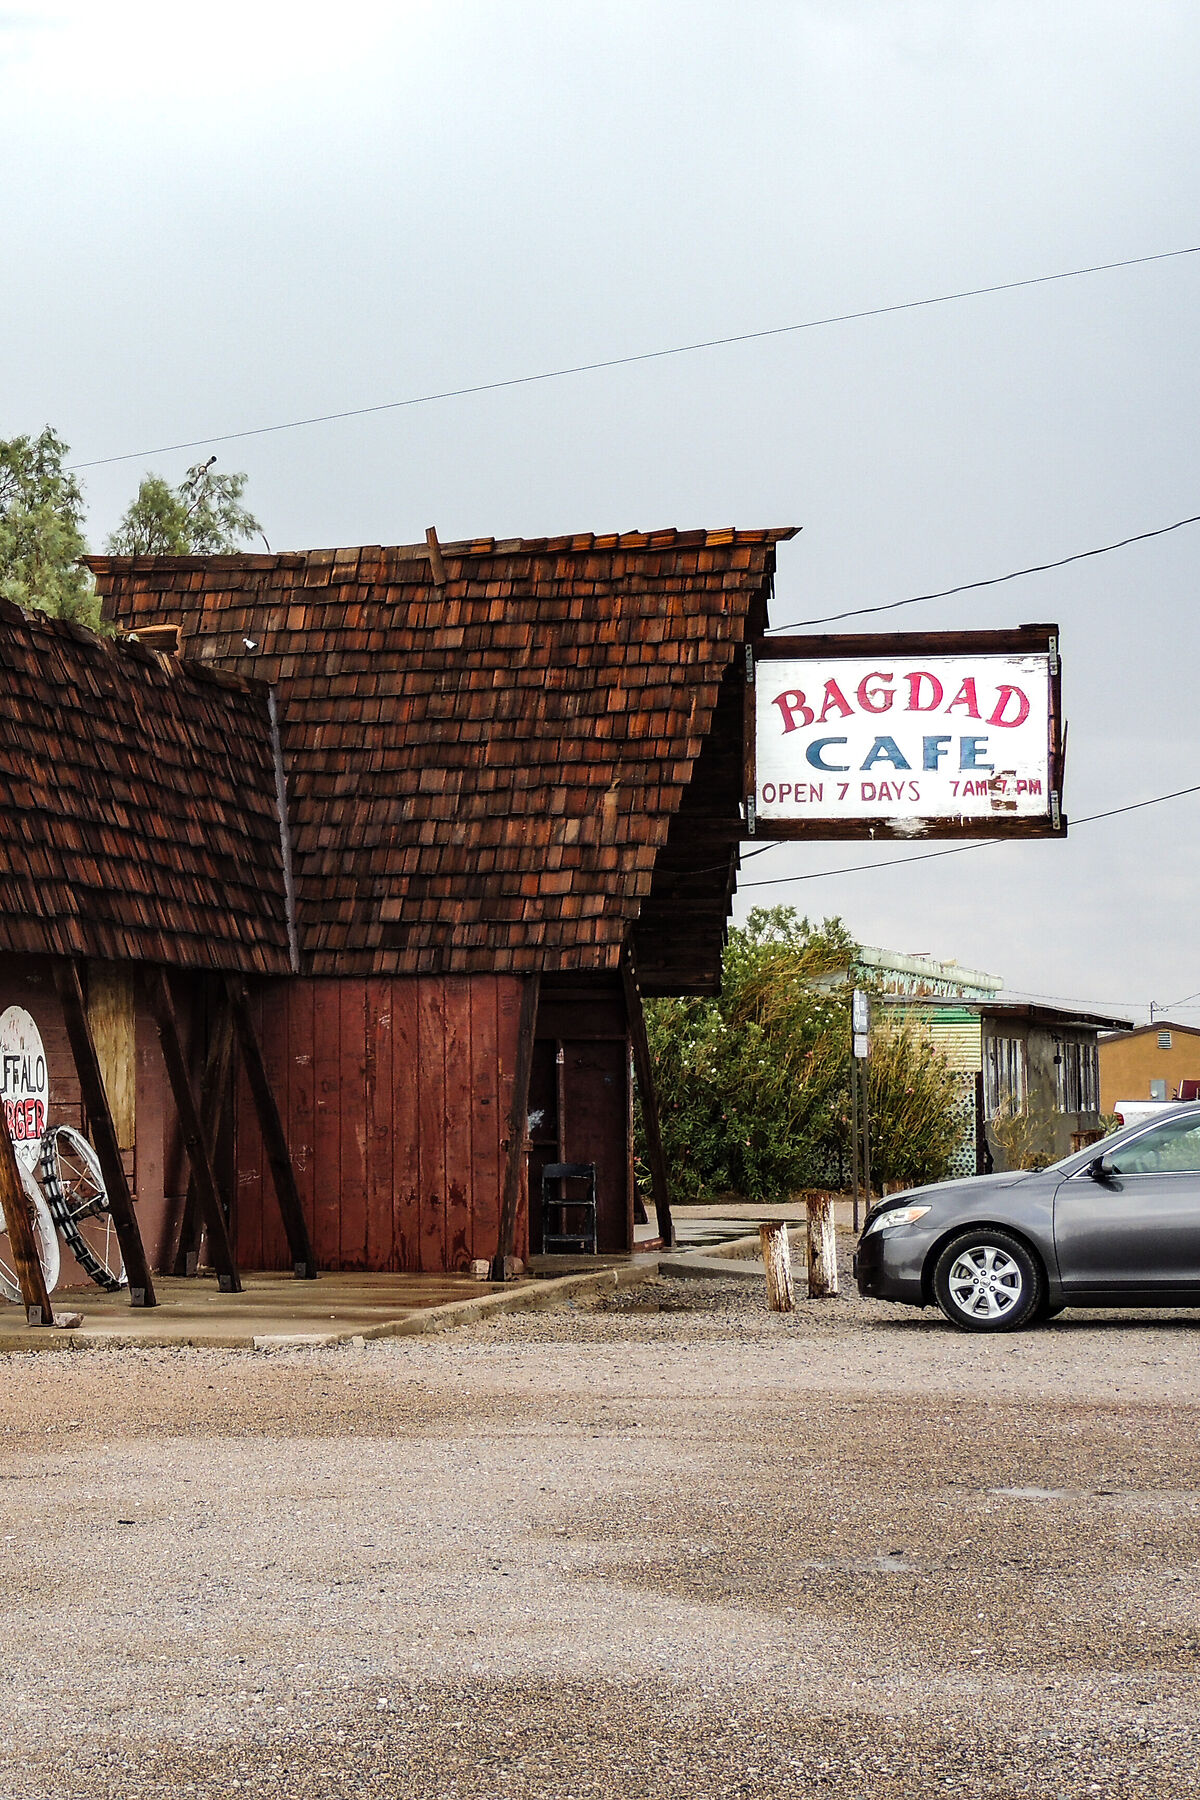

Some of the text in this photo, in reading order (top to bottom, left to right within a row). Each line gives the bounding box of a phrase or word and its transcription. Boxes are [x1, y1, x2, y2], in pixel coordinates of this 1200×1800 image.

[772, 671, 1030, 735] BAGDAD
[805, 736, 995, 771] CAFE
[762, 782, 824, 803] OPEN
[836, 782, 850, 801] 7
[861, 780, 921, 801] DAYS
